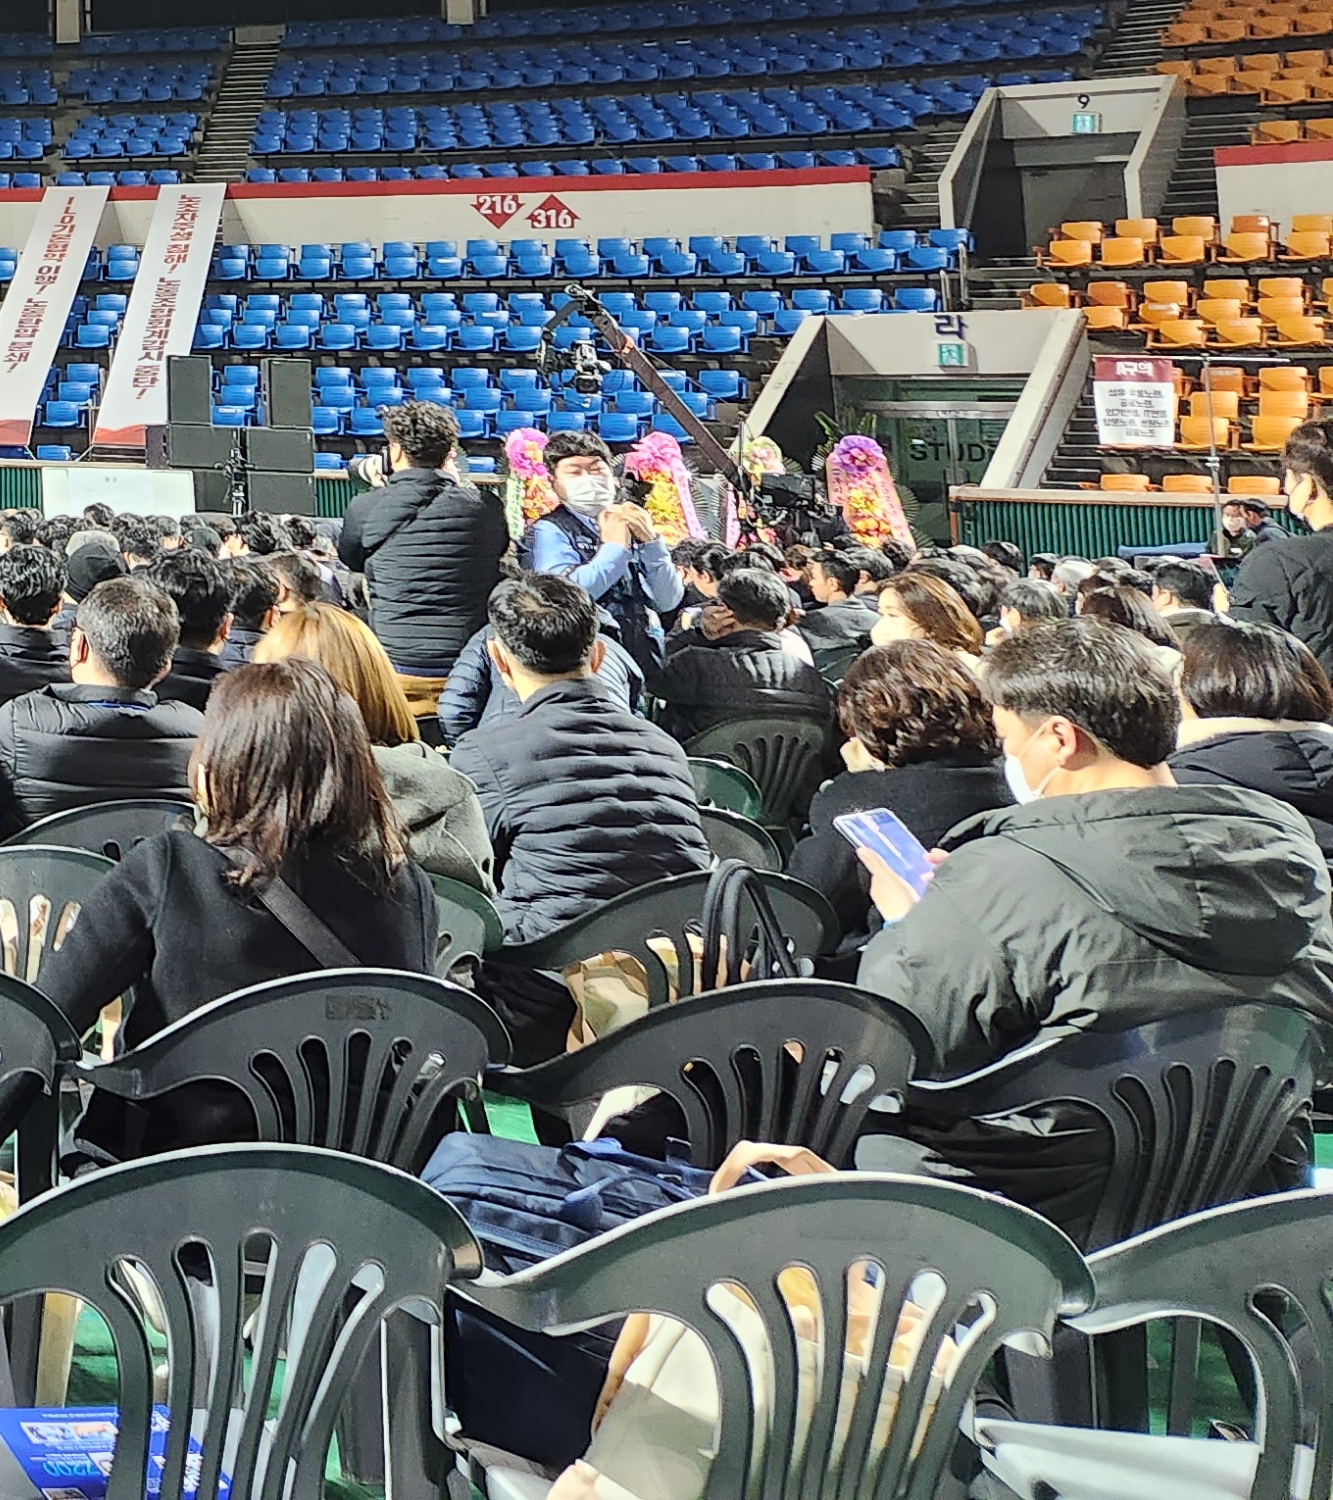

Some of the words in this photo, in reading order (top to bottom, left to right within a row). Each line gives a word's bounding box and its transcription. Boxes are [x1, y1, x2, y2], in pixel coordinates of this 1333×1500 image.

[1077, 93, 1091, 110] 9
[169, 193, 202, 242] 노조자주성
[478, 195, 517, 214] 216
[532, 209, 572, 228] 316
[163, 244, 190, 275] 침해!
[33, 265, 62, 295] 이행!
[933, 314, 969, 342] 라
[132, 365, 161, 400] 중단!
[910, 438, 996, 463] STUD
